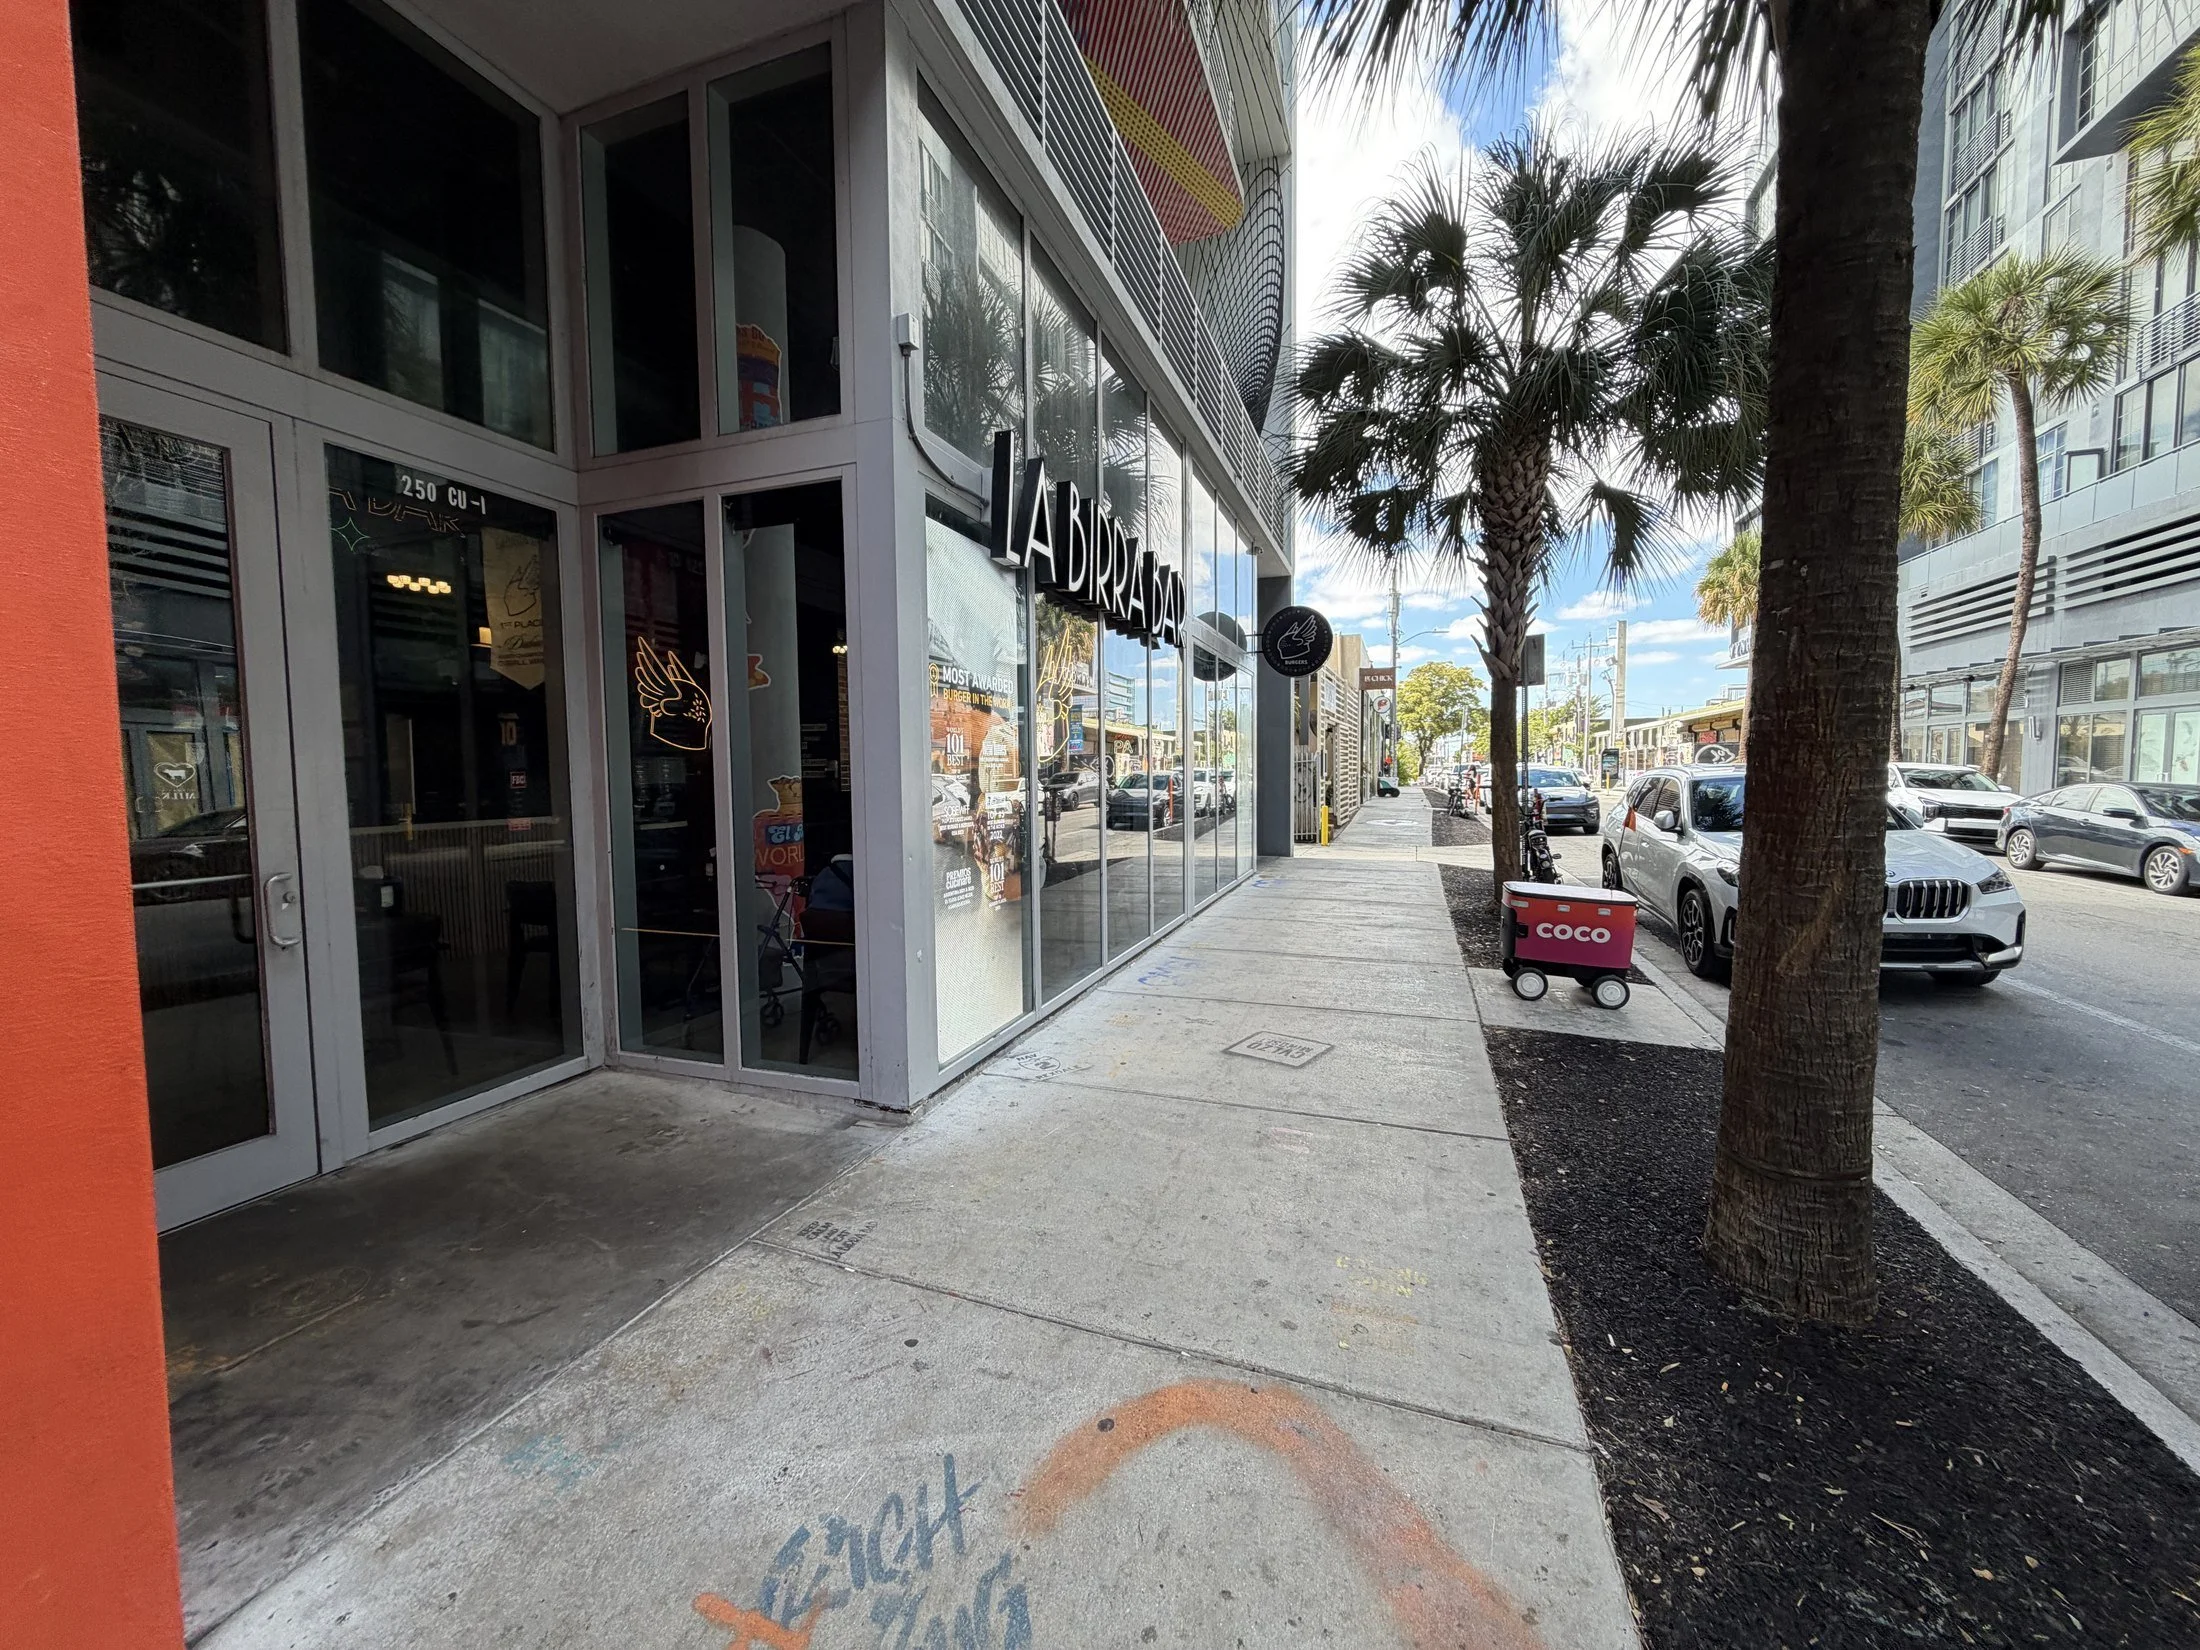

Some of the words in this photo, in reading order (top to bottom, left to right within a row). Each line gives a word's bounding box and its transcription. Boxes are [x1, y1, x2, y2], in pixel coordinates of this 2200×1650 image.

[401, 475, 437, 502] 250
[1003, 430, 1057, 584] LA
[1066, 480, 1147, 629] BIRRA
[1152, 550, 1187, 648] BAR
[514, 619, 544, 628] PLAC
[943, 665, 970, 687] MOST
[971, 671, 1014, 695] AWARDED
[943, 687, 972, 705] BURGER
[972, 692, 980, 705] IN
[980, 694, 993, 707] THE
[946, 733, 965, 754] 101
[946, 753, 965, 767] BEST
[989, 862, 1006, 882] 101
[989, 881, 1006, 894] BEST
[1536, 922, 1611, 944] COCO
